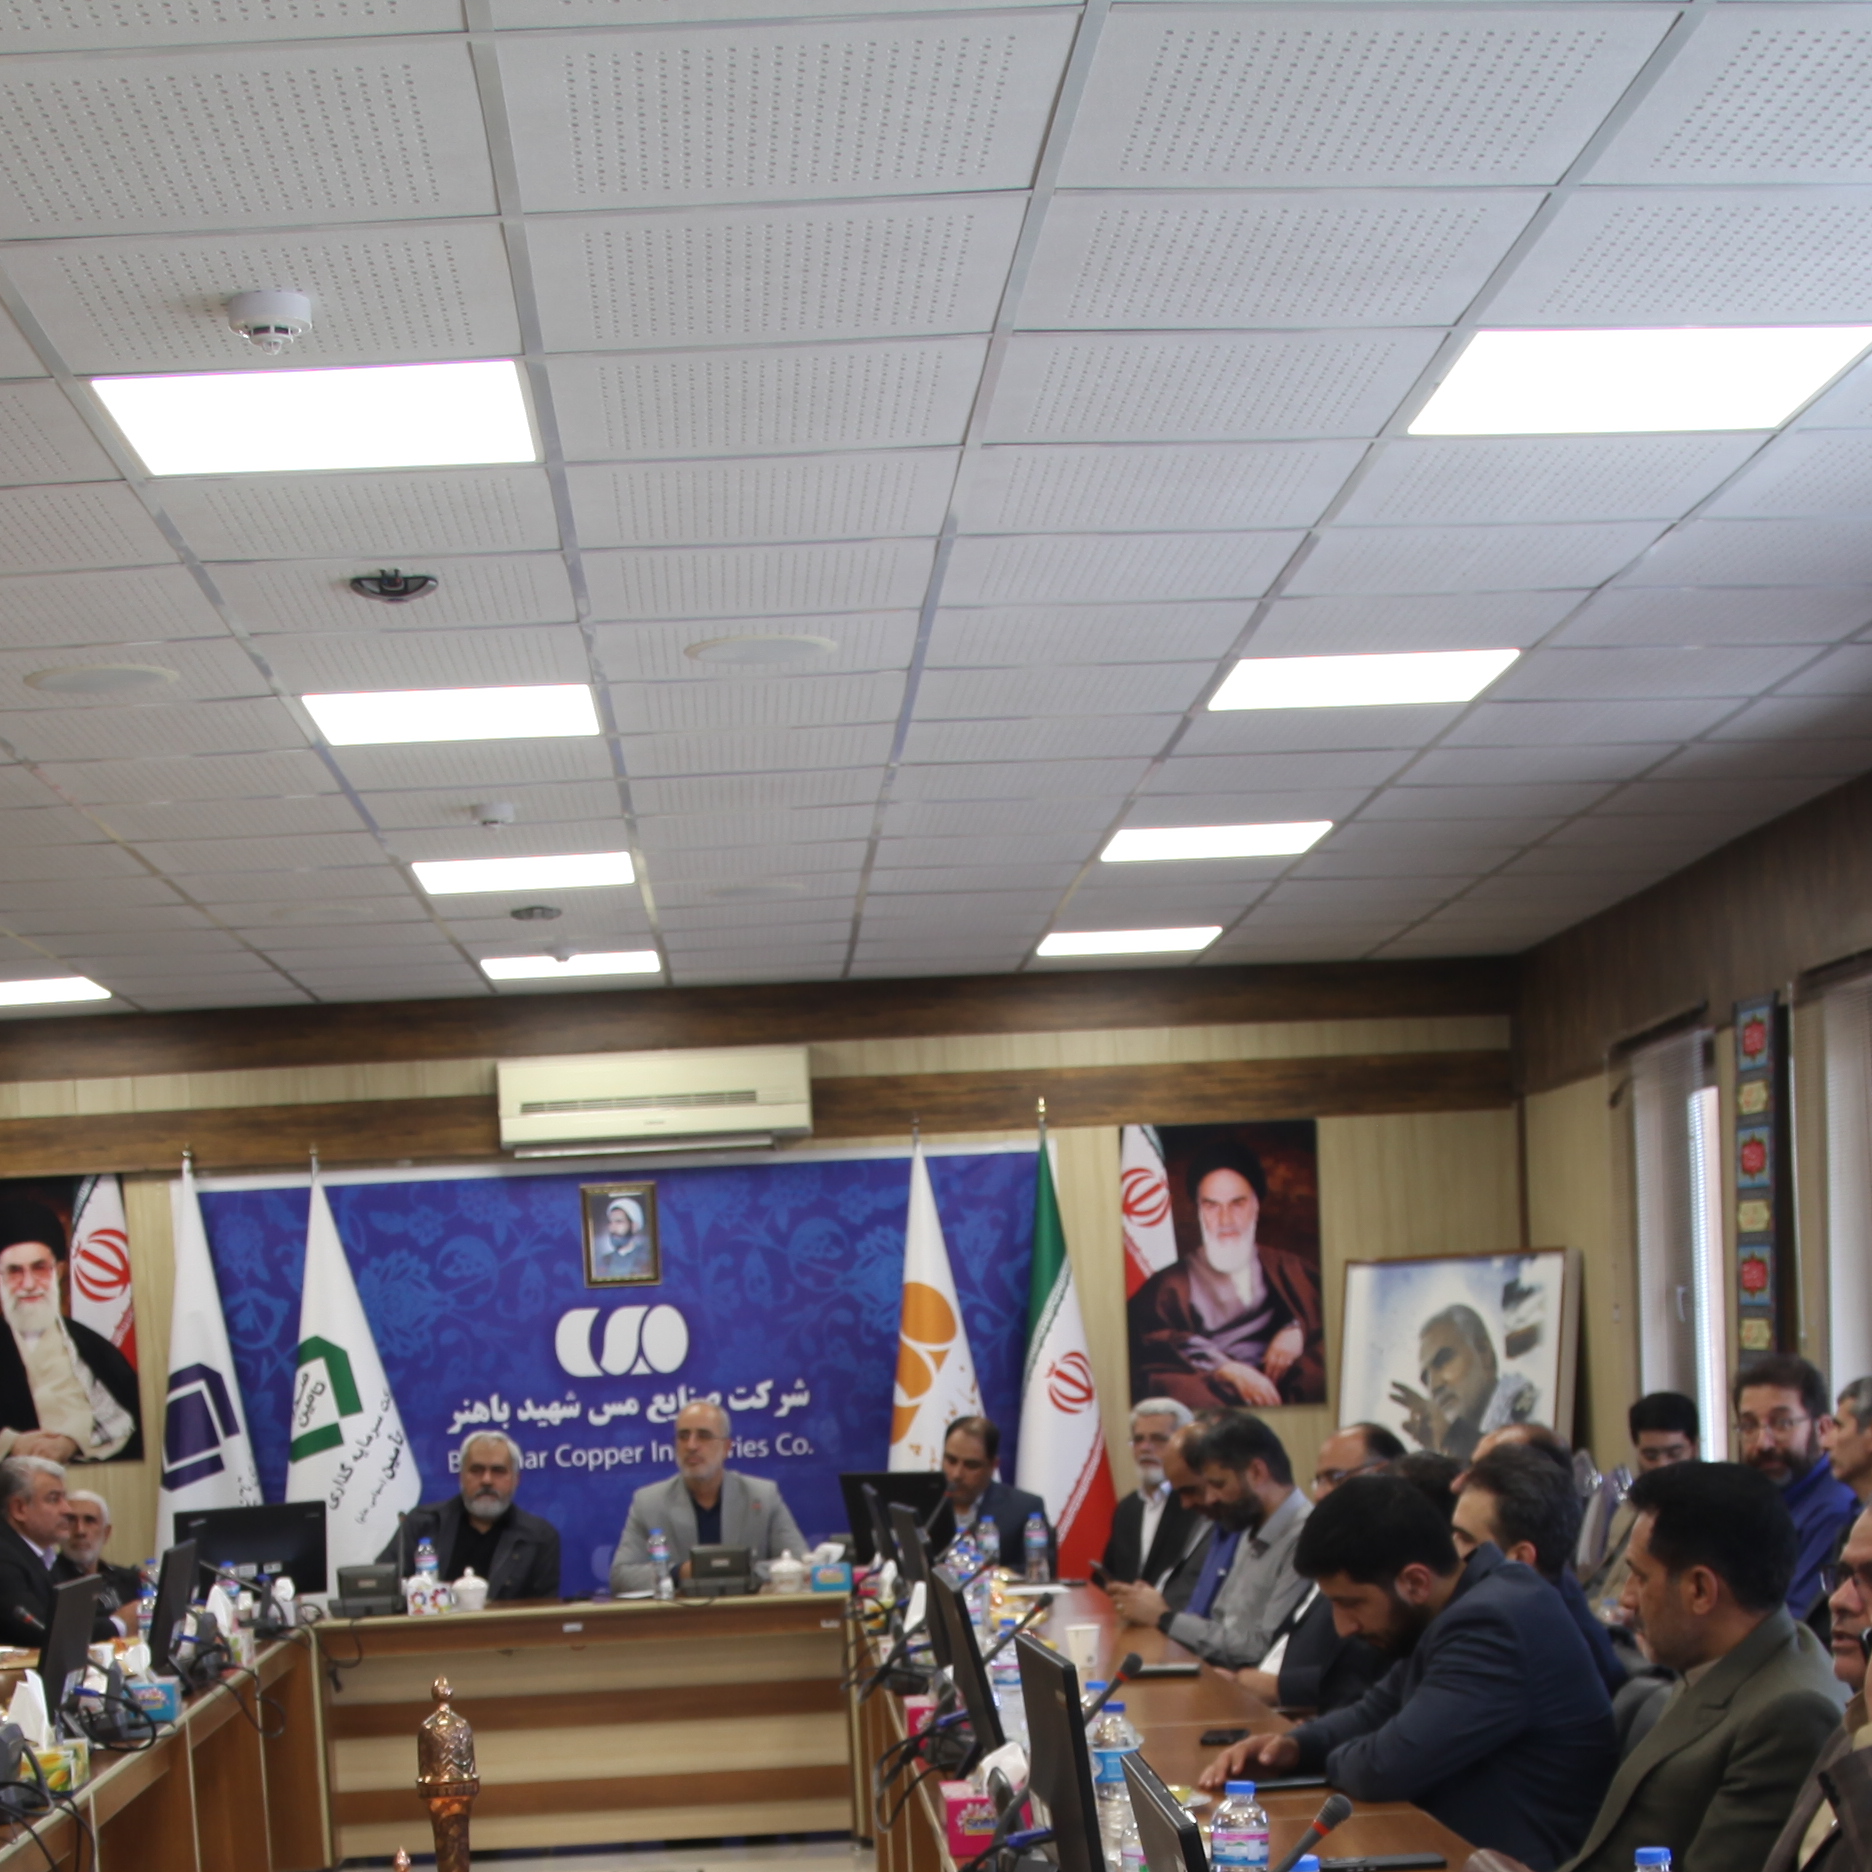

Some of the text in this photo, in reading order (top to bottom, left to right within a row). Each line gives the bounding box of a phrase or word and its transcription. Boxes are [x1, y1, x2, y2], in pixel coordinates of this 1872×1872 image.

[447, 1392, 511, 1434] باهنر
[517, 1390, 582, 1428] شهید
[589, 1394, 639, 1426] مس
[727, 1377, 810, 1418] شرکت
[554, 1443, 644, 1471] Copper
[651, 1434, 770, 1464] Inries
[775, 1432, 814, 1457] Co.
